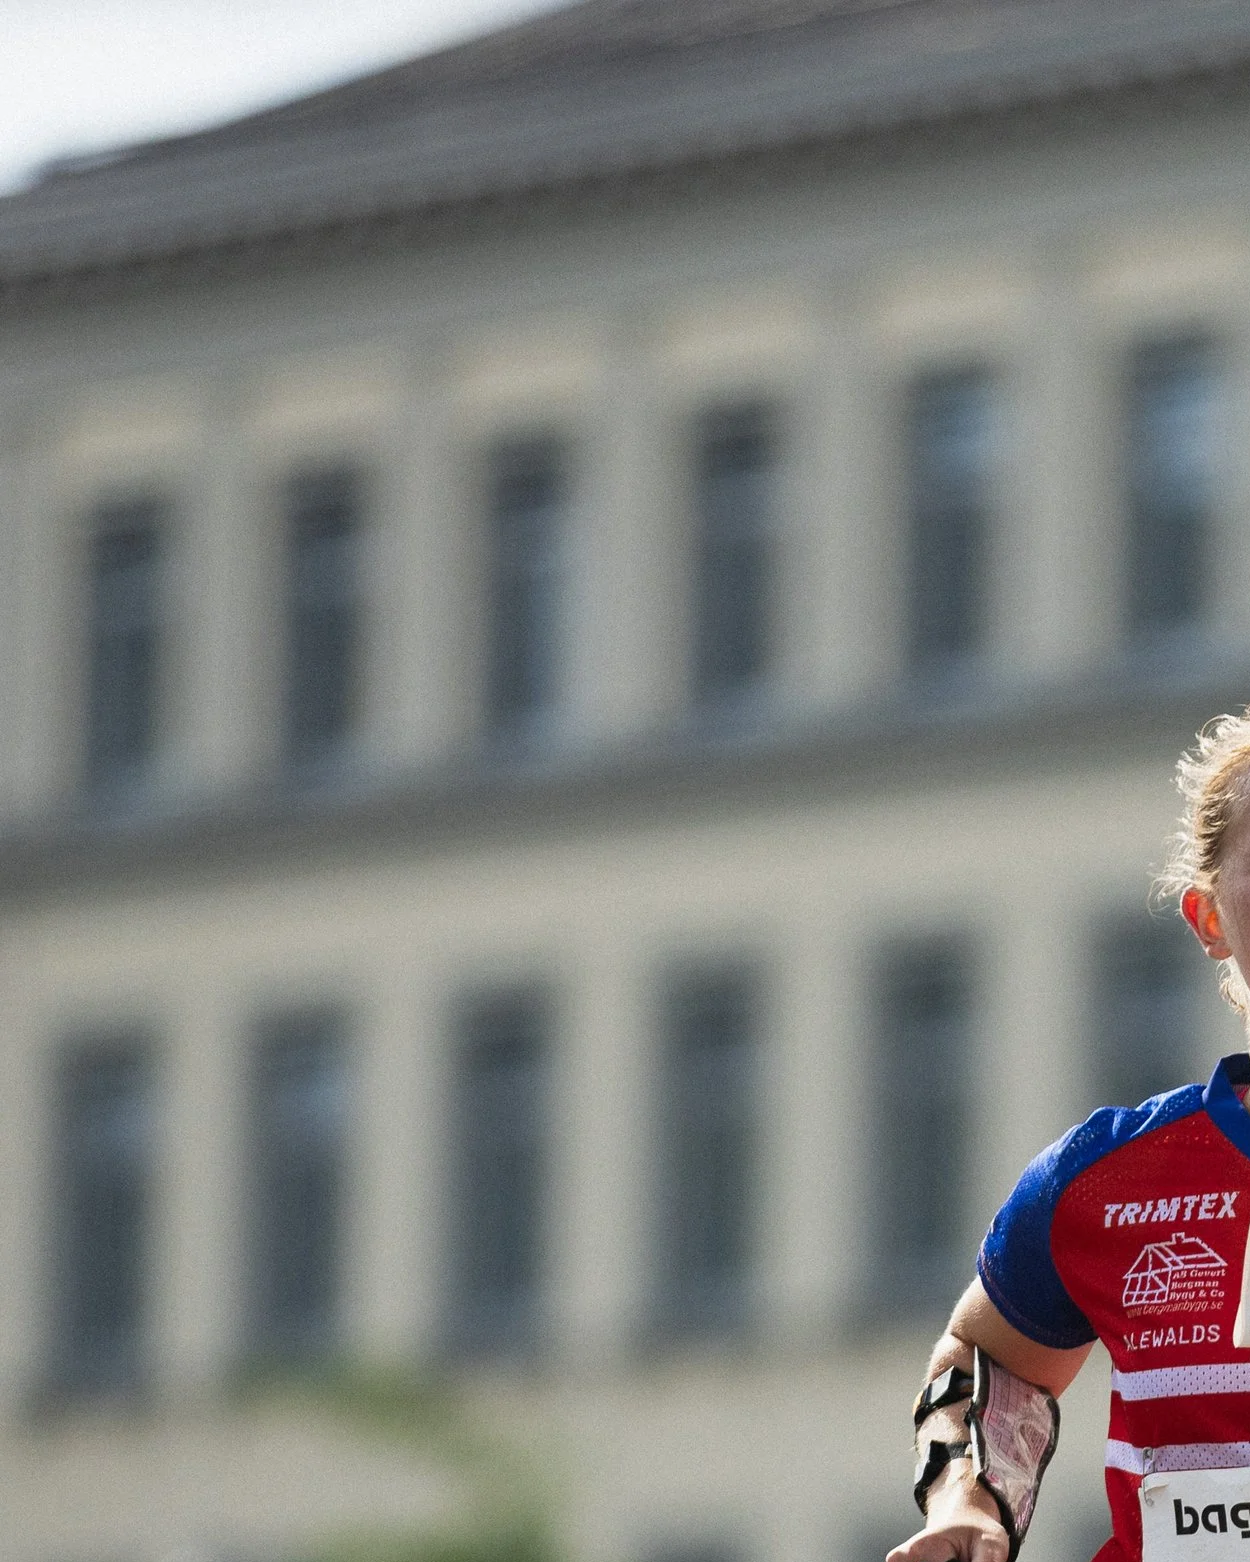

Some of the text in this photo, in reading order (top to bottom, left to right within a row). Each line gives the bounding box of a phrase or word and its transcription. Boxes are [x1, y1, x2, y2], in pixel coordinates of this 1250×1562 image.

[1104, 1191, 1240, 1228] TRIMTEX
[1172, 1270, 1188, 1280] AB
[1198, 1289, 1207, 1298] &
[1209, 1288, 1225, 1298] Co
